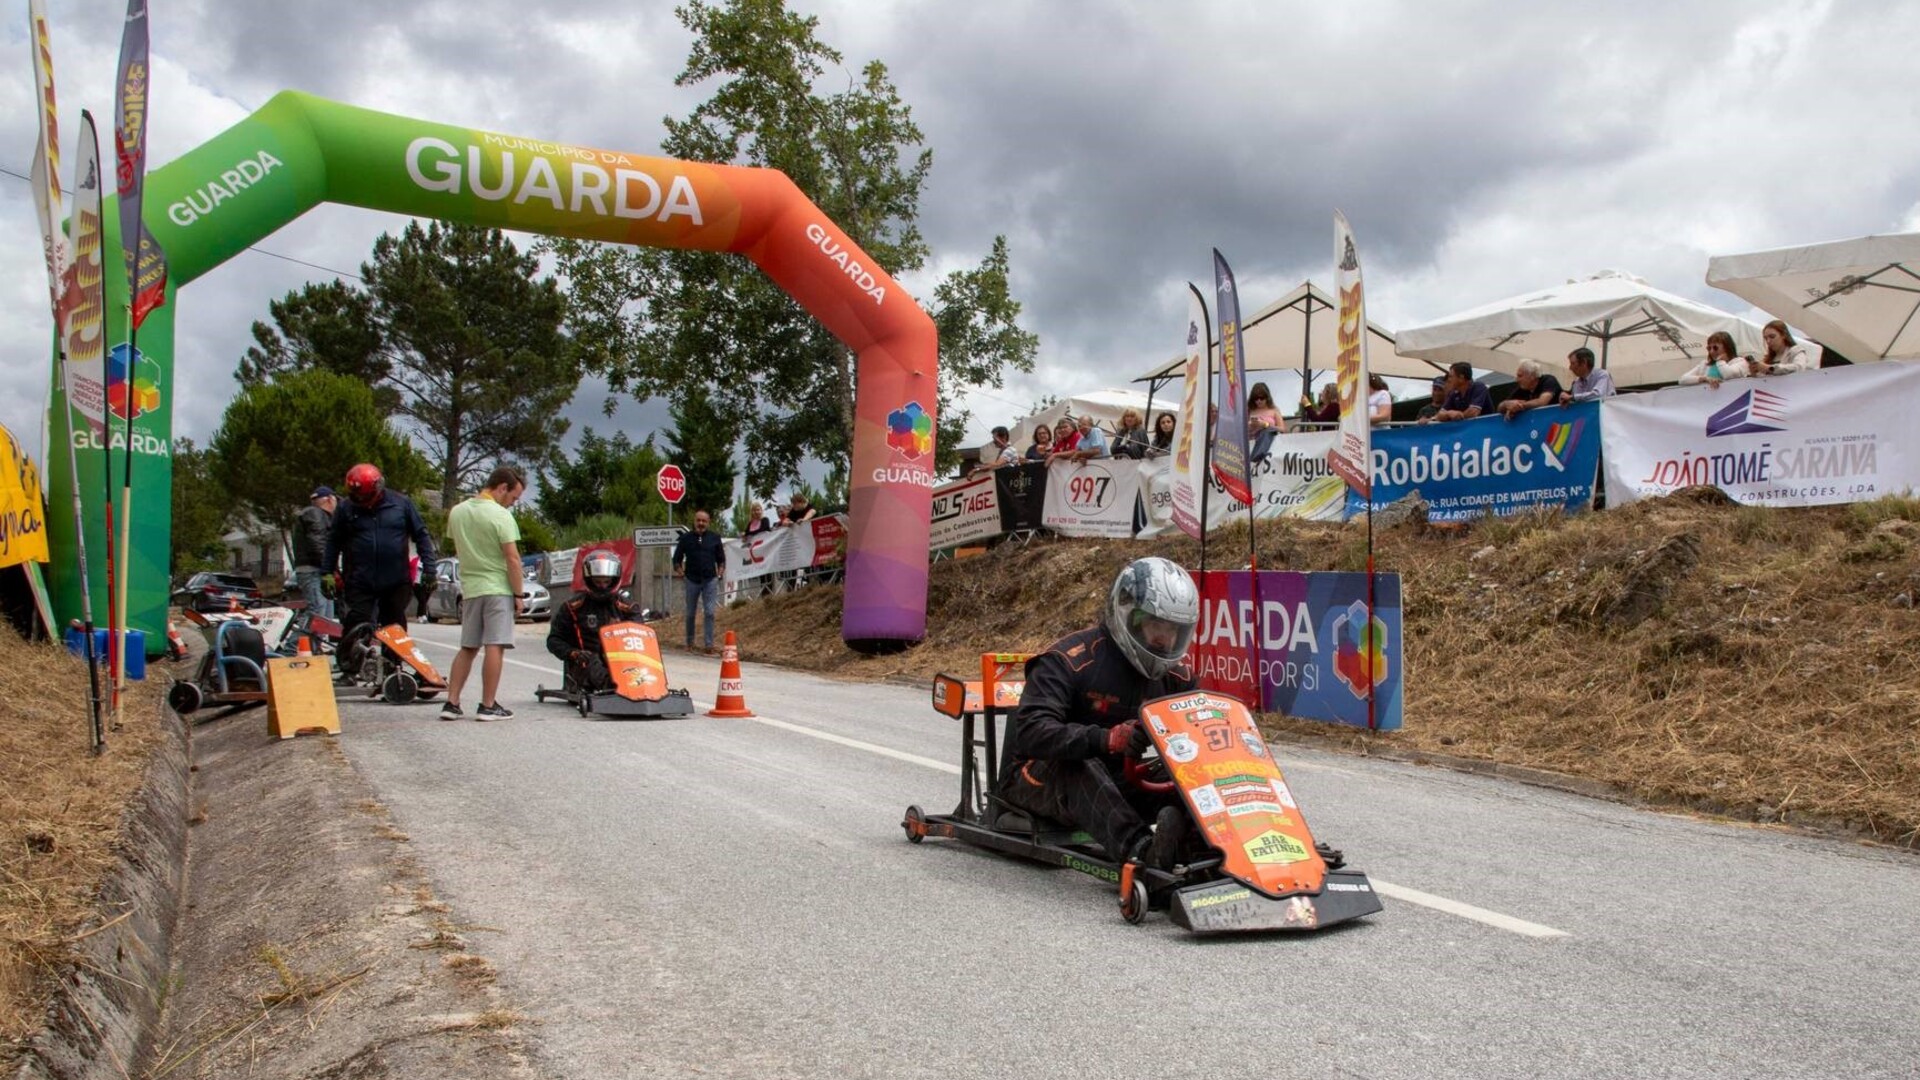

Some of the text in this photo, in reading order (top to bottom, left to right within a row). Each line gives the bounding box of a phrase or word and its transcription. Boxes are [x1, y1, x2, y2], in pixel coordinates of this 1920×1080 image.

[484, 133, 632, 167] MUNICÍPIO DA
[168, 150, 284, 227] GUARDA
[405, 137, 704, 226] GUARDA
[806, 224, 886, 305] GUARDA
[1371, 437, 1534, 487] Robbialac
[1773, 442, 1878, 480] SARAIVA
[659, 475, 685, 492] STOP
[873, 468, 933, 488] GUARD
[1070, 477, 1111, 508] 997
[1849, 483, 1876, 494] LDA
[1268, 489, 1305, 506] Gare
[1440, 497, 1458, 508] RUA
[1459, 494, 1496, 507] CIDADE
[1497, 492, 1509, 504] DE
[1510, 487, 1569, 503] WATTRELOS,
[1191, 599, 1319, 653] UARDA
[622, 636, 645, 651] 38
[1260, 659, 1298, 688] POR
[1302, 662, 1320, 691] SI
[1250, 843, 1305, 858] FATINHA
[1260, 834, 1288, 846] BAR
[1063, 854, 1120, 882] Tebosa
